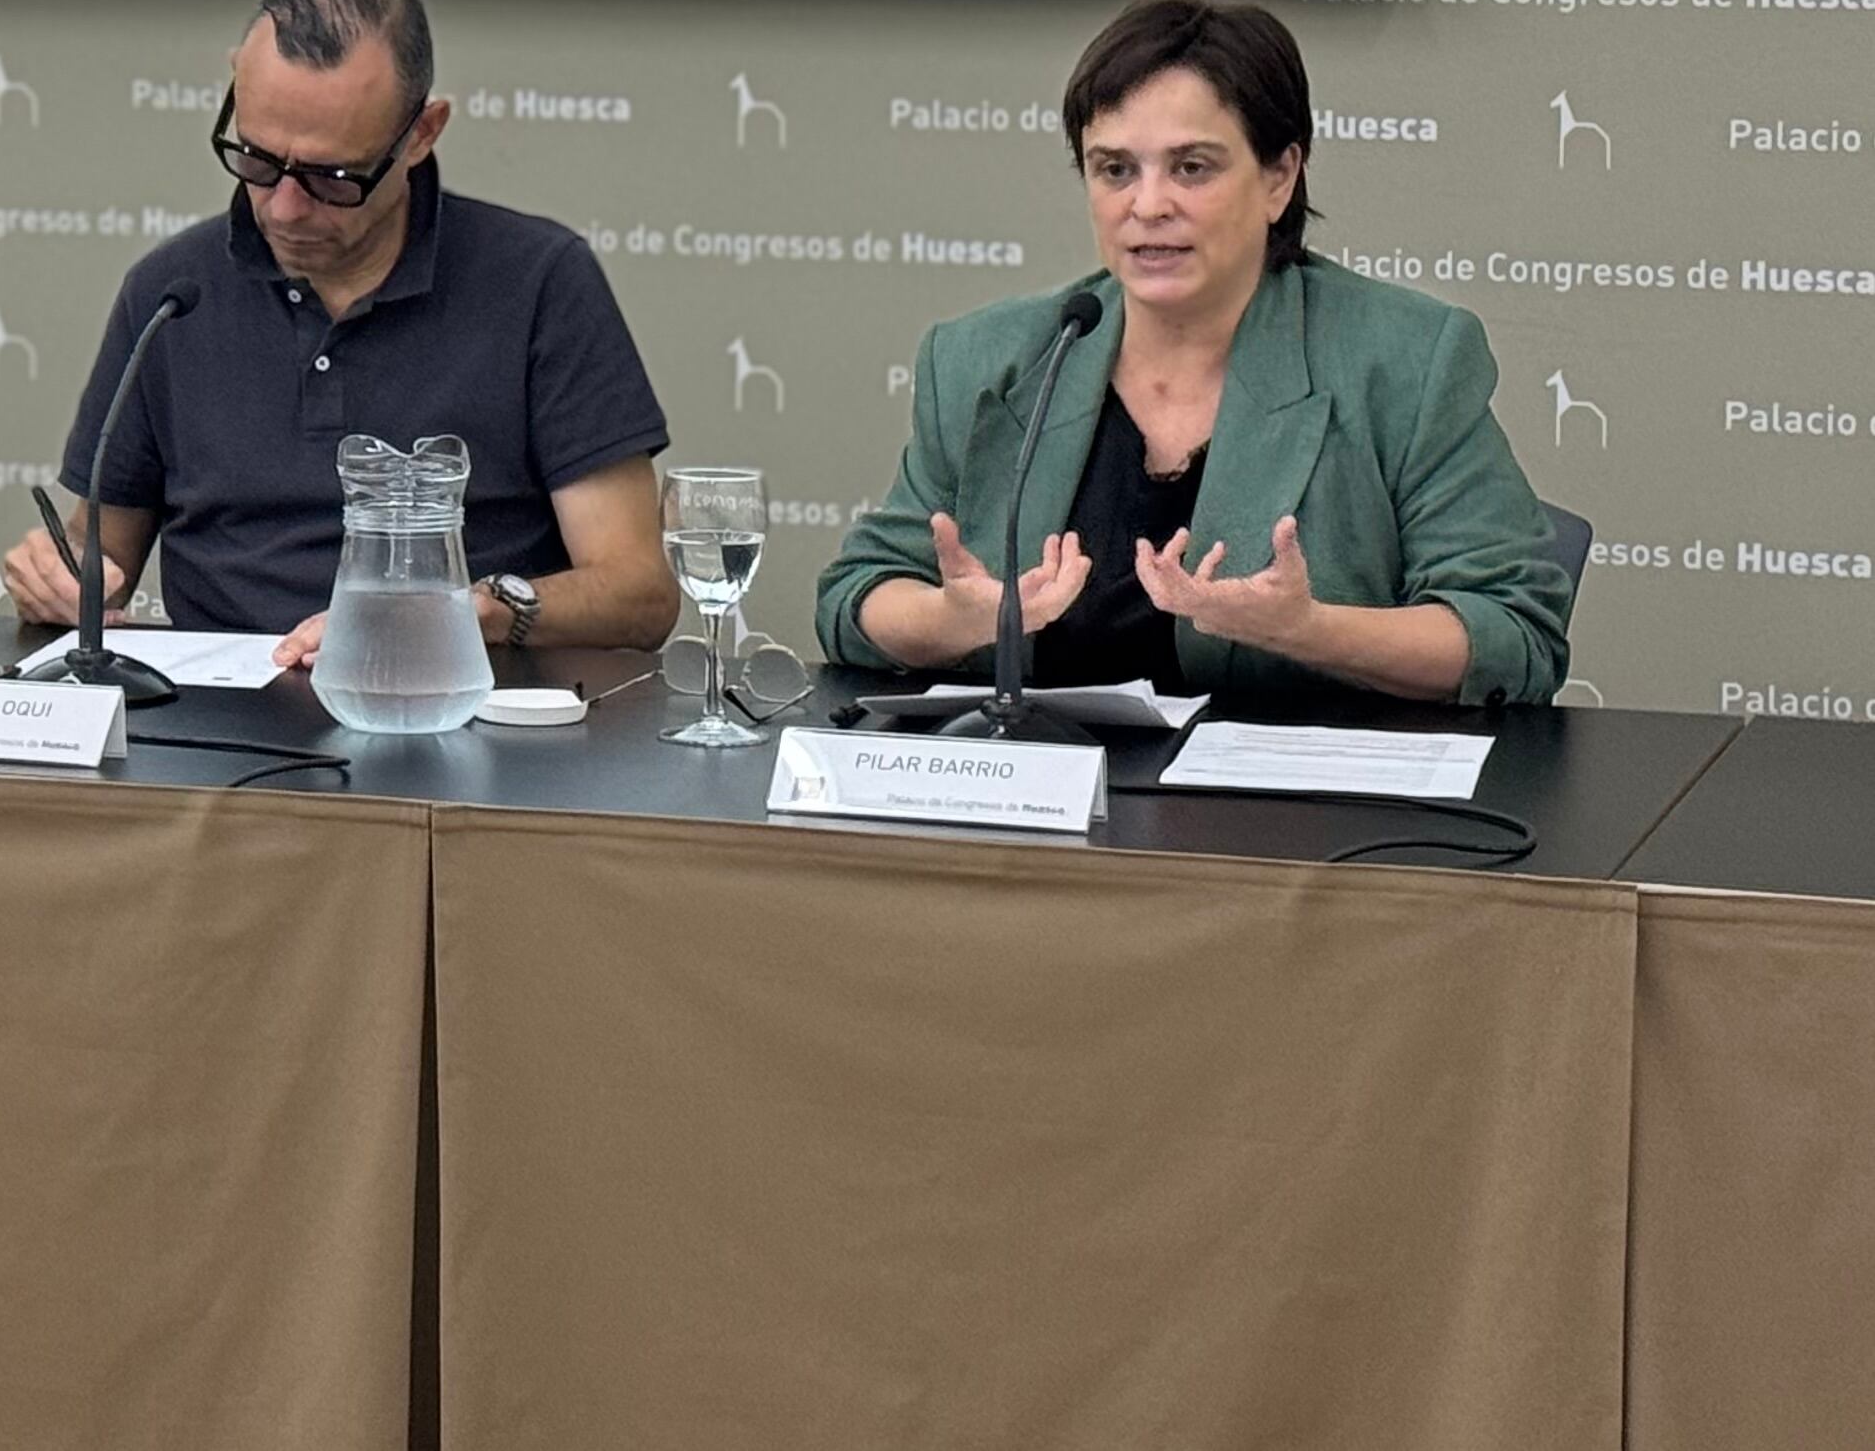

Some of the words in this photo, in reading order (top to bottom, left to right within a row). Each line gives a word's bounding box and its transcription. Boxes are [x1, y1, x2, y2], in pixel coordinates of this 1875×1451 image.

[468, 89, 505, 118] de
[515, 91, 630, 121] Huesca
[891, 99, 1009, 131] Palacio
[1312, 109, 1437, 141] Huesca
[1730, 120, 1861, 151] Palacio
[98, 208, 133, 235] de
[626, 224, 664, 254] de
[674, 225, 844, 264] Congresos
[853, 232, 891, 261] de
[903, 233, 1023, 265] Huesca
[1435, 251, 1475, 280] de
[1488, 253, 1674, 292] Congresos
[1687, 259, 1728, 289] de
[1742, 261, 1875, 294] Huesca
[1726, 401, 1856, 435] Palacio
[1684, 540, 1724, 570] de
[1738, 543, 1871, 578] Huesca
[1722, 682, 1852, 719] Palacio
[856, 753, 921, 772] PILAR
[929, 758, 1014, 779] BARRIO
